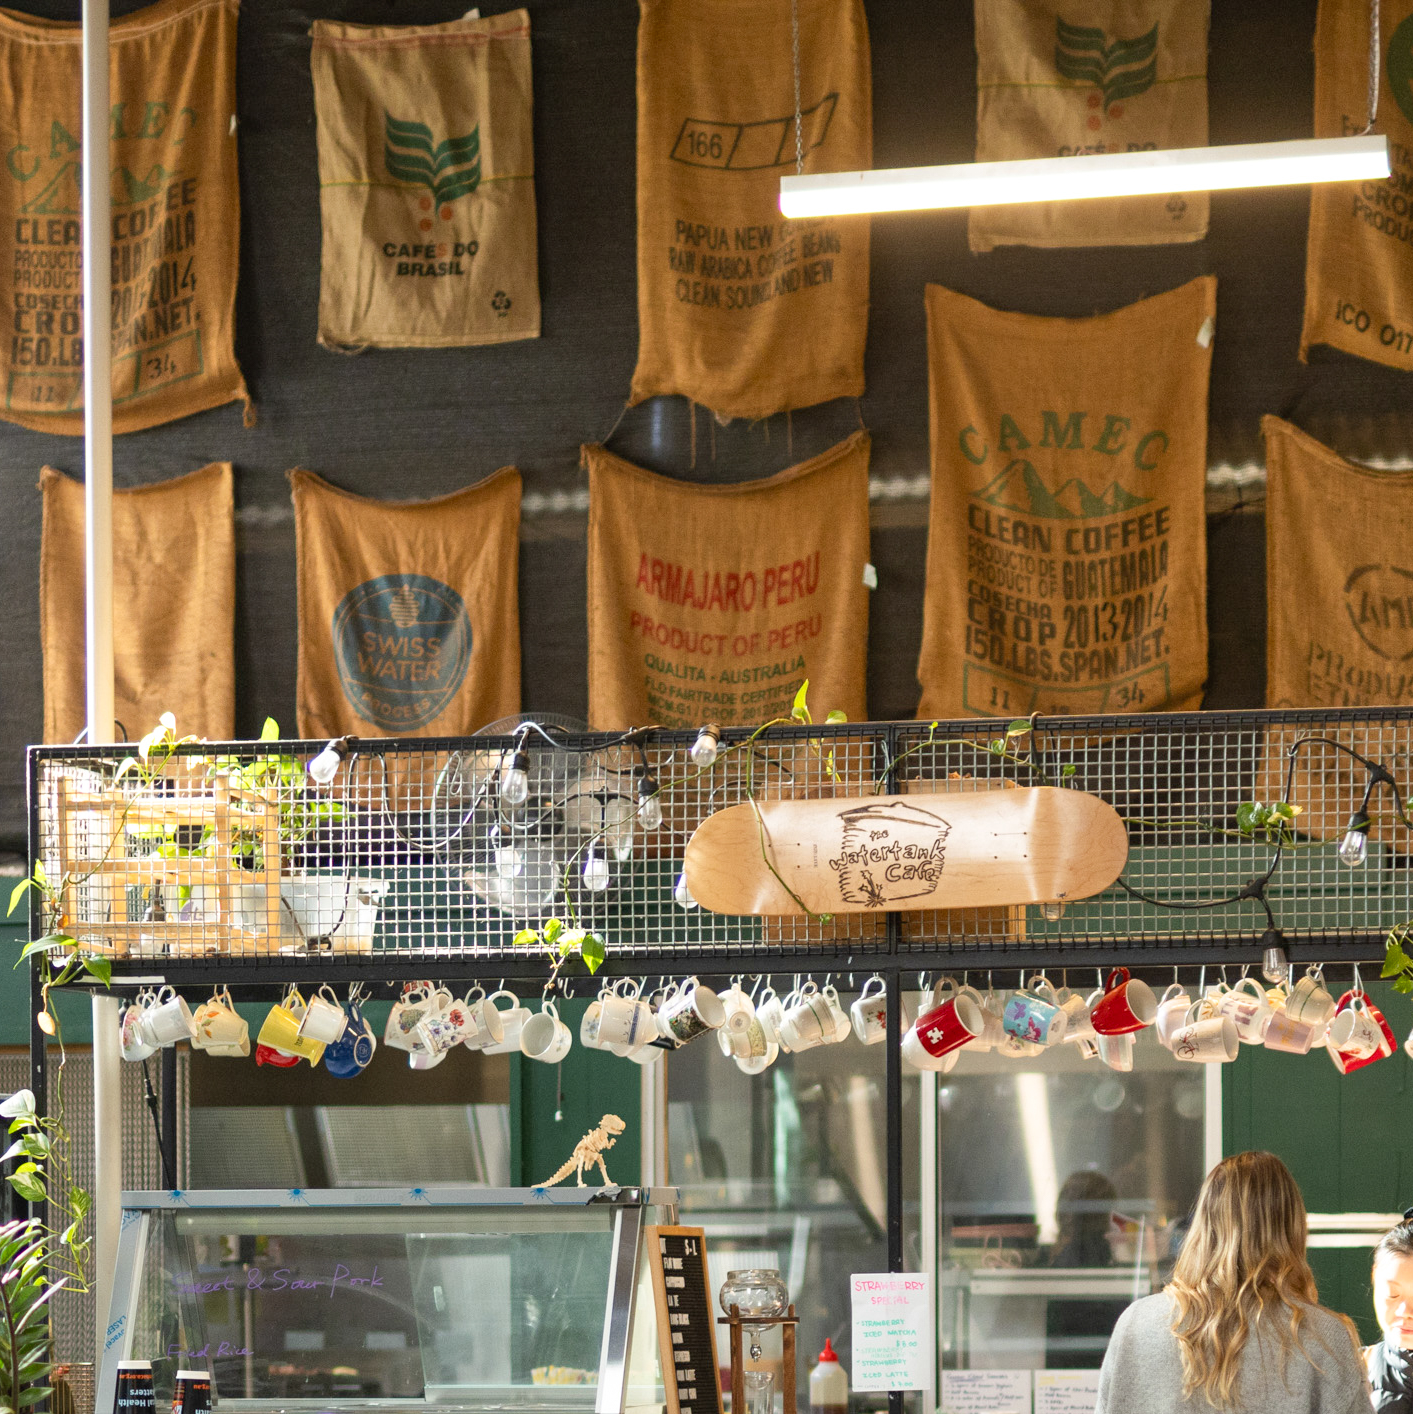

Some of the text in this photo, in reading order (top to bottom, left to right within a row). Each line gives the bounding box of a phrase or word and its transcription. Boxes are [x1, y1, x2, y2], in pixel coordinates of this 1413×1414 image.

[687, 130, 723, 159] 166
[16, 218, 82, 246] CLEA
[676, 219, 729, 251] PAPUA
[734, 225, 774, 251] NEW
[454, 240, 479, 257] DO
[397, 260, 465, 277] BRASIL
[13, 309, 80, 336] CRO
[1336, 300, 1371, 333] ICO
[958, 410, 1170, 472] CAMEC
[967, 503, 1171, 556] CLEAN COFFEE
[637, 550, 821, 613] ARMAJARO PERU
[1039, 556, 1057, 580] DE
[1062, 539, 1169, 601] GUATEMALA
[1038, 576, 1059, 600] OF
[630, 609, 823, 657] PRODUCT OF PERU
[967, 594, 1057, 647] CROP
[363, 631, 442, 658] SWISS
[357, 651, 441, 682] WATER
[644, 652, 707, 682] QUALITA
[719, 654, 807, 685] AUSTRALIA
[644, 675, 668, 695] FLO
[869, 829, 890, 842] the
[272, 1267, 326, 1292] Sour
[329, 1263, 385, 1299] Pork
[854, 1280, 926, 1292] STRAWBERRY
[216, 1340, 255, 1358] Rice
[129, 1388, 154, 1397] atters
